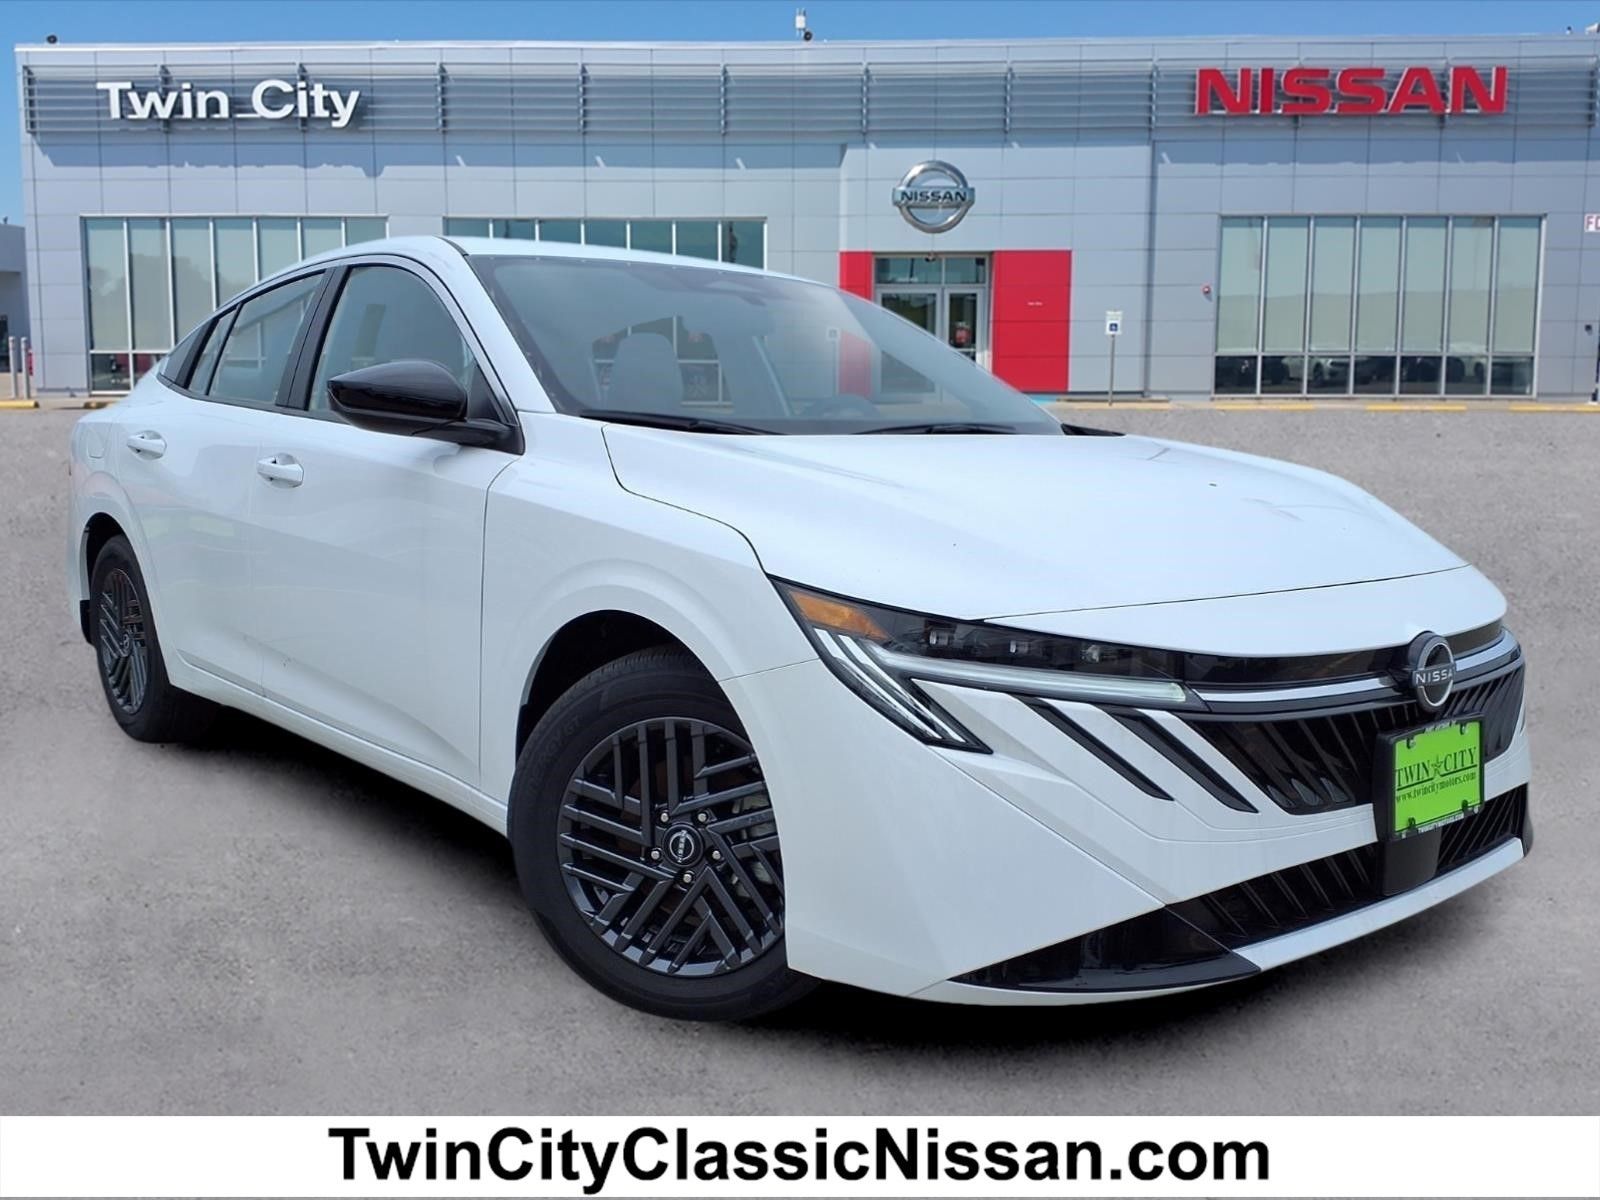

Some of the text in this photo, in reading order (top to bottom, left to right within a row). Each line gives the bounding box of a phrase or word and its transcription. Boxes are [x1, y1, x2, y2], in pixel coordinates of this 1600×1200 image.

[96, 79, 360, 128] Twin City
[1194, 66, 1508, 115] NISSAN
[900, 191, 967, 203] NISSAN
[1415, 668, 1454, 685] NISSA
[1396, 746, 1477, 787] TWIN CITY
